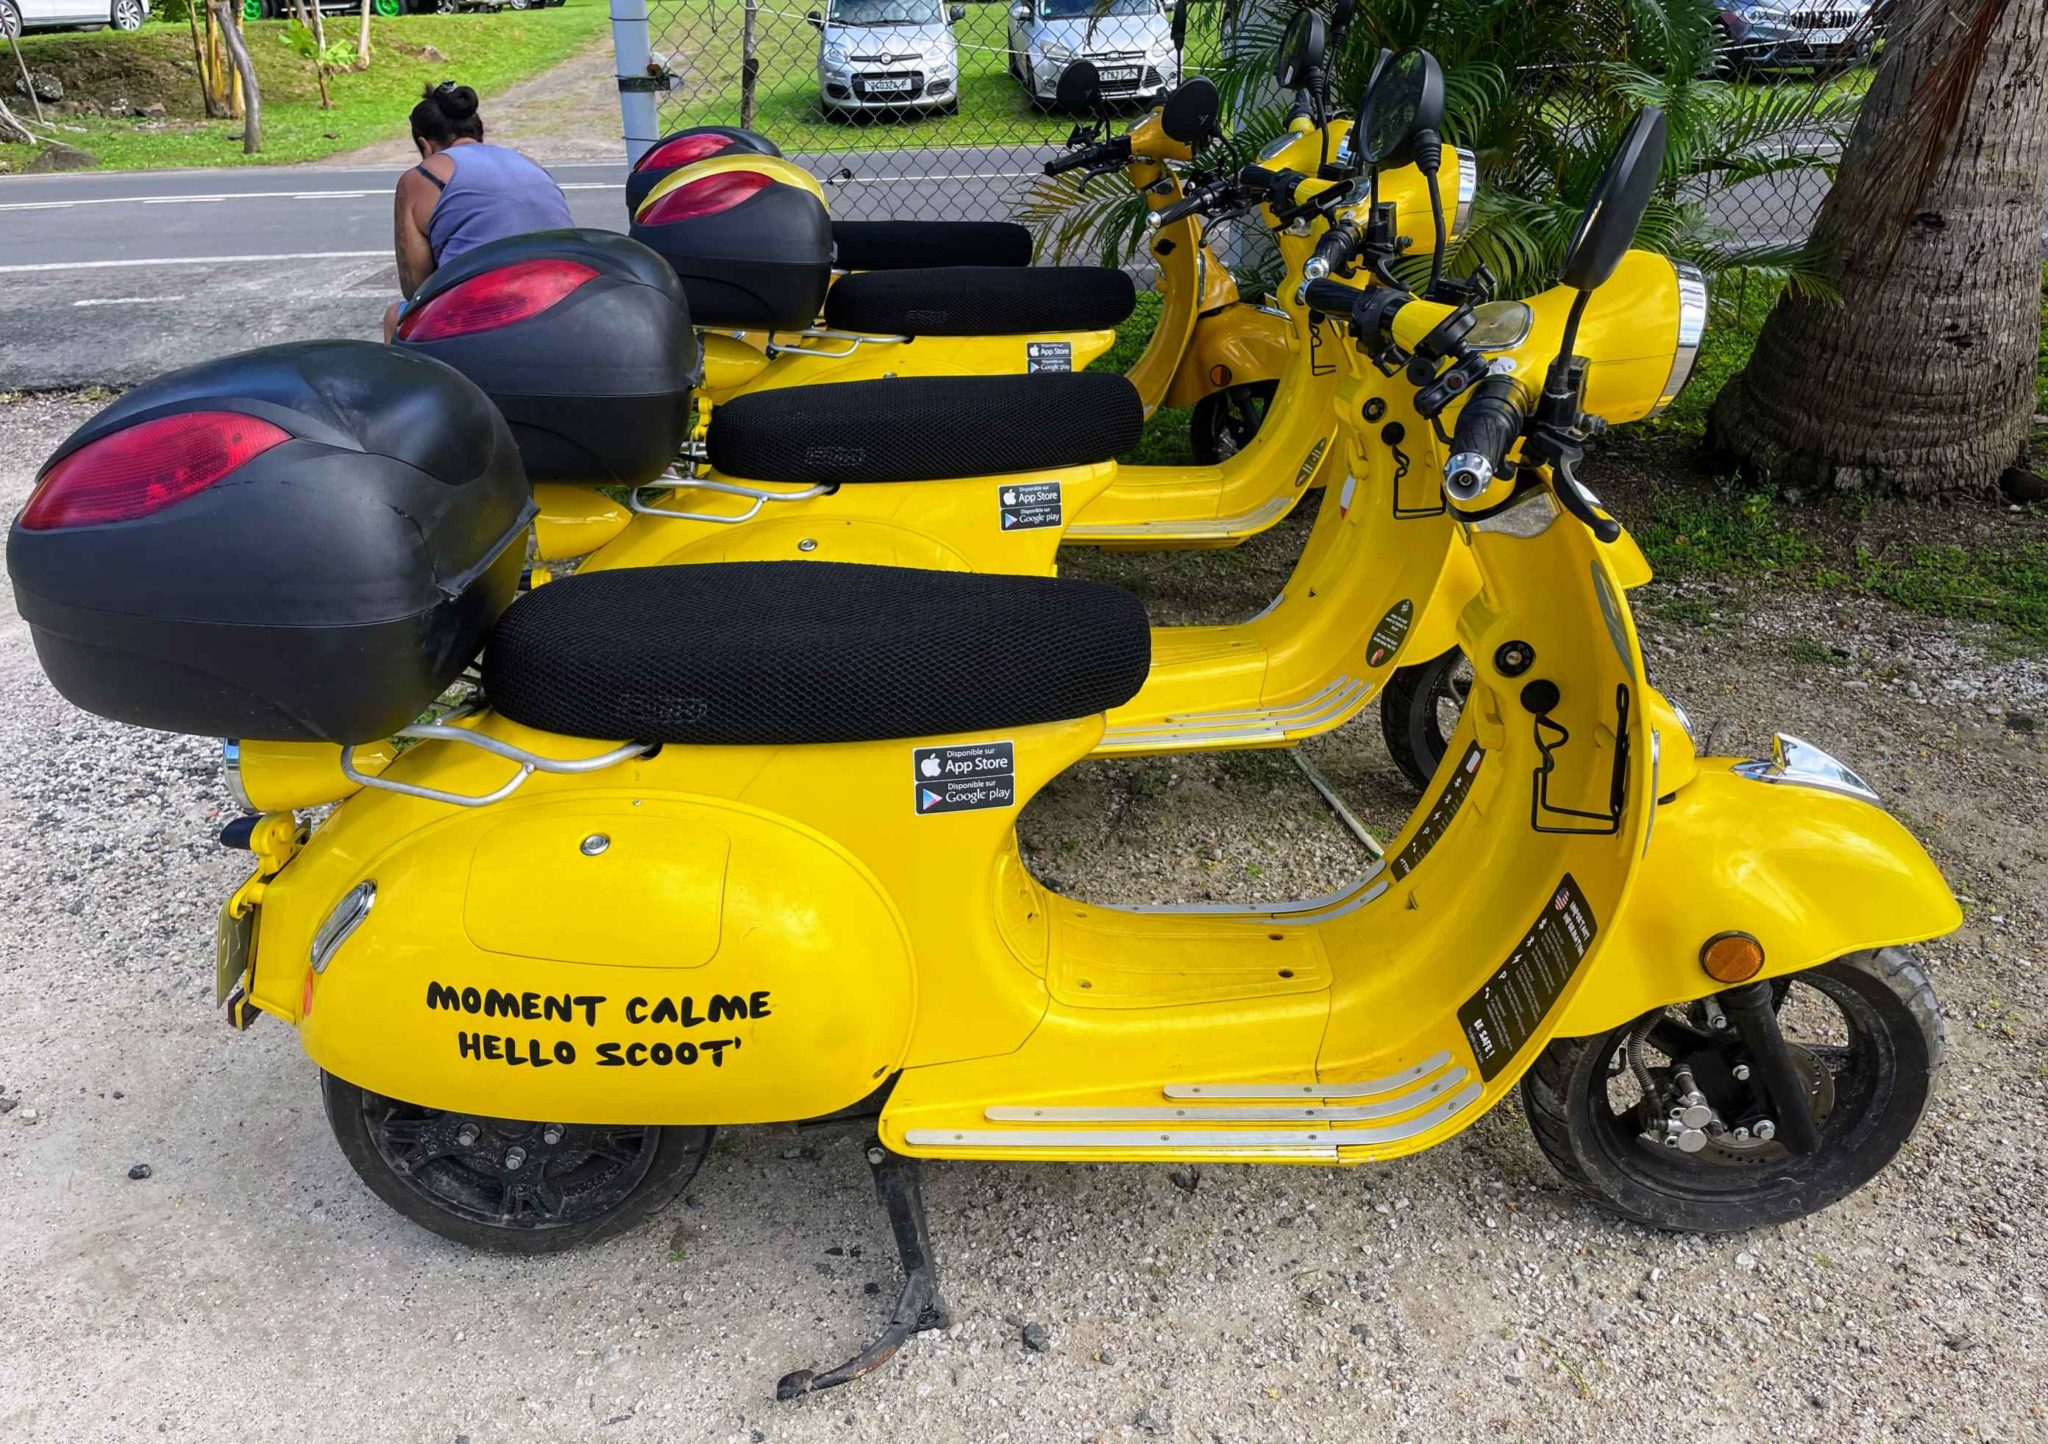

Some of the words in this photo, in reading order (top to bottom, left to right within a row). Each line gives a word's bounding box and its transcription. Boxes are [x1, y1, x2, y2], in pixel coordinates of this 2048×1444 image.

[1040, 347, 1053, 356] App
[1018, 493, 1036, 504] App
[1037, 491, 1058, 501] Store
[1019, 513, 1045, 524] Google
[1046, 512, 1059, 522] play
[946, 748, 983, 758] Disponible
[945, 760, 973, 775] App
[975, 757, 1008, 770] Store
[947, 780, 984, 790] Disponible
[945, 788, 987, 804] Google
[989, 787, 1010, 801] play
[1569, 900, 1591, 941] IMPORTANT
[1563, 911, 1585, 958] INFORMATION
[426, 980, 607, 1027] MOMENT
[626, 990, 772, 1028] CALME
[1473, 1018, 1484, 1031] BE
[1479, 1030, 1493, 1052] SAFE
[458, 1031, 576, 1067] HELLO
